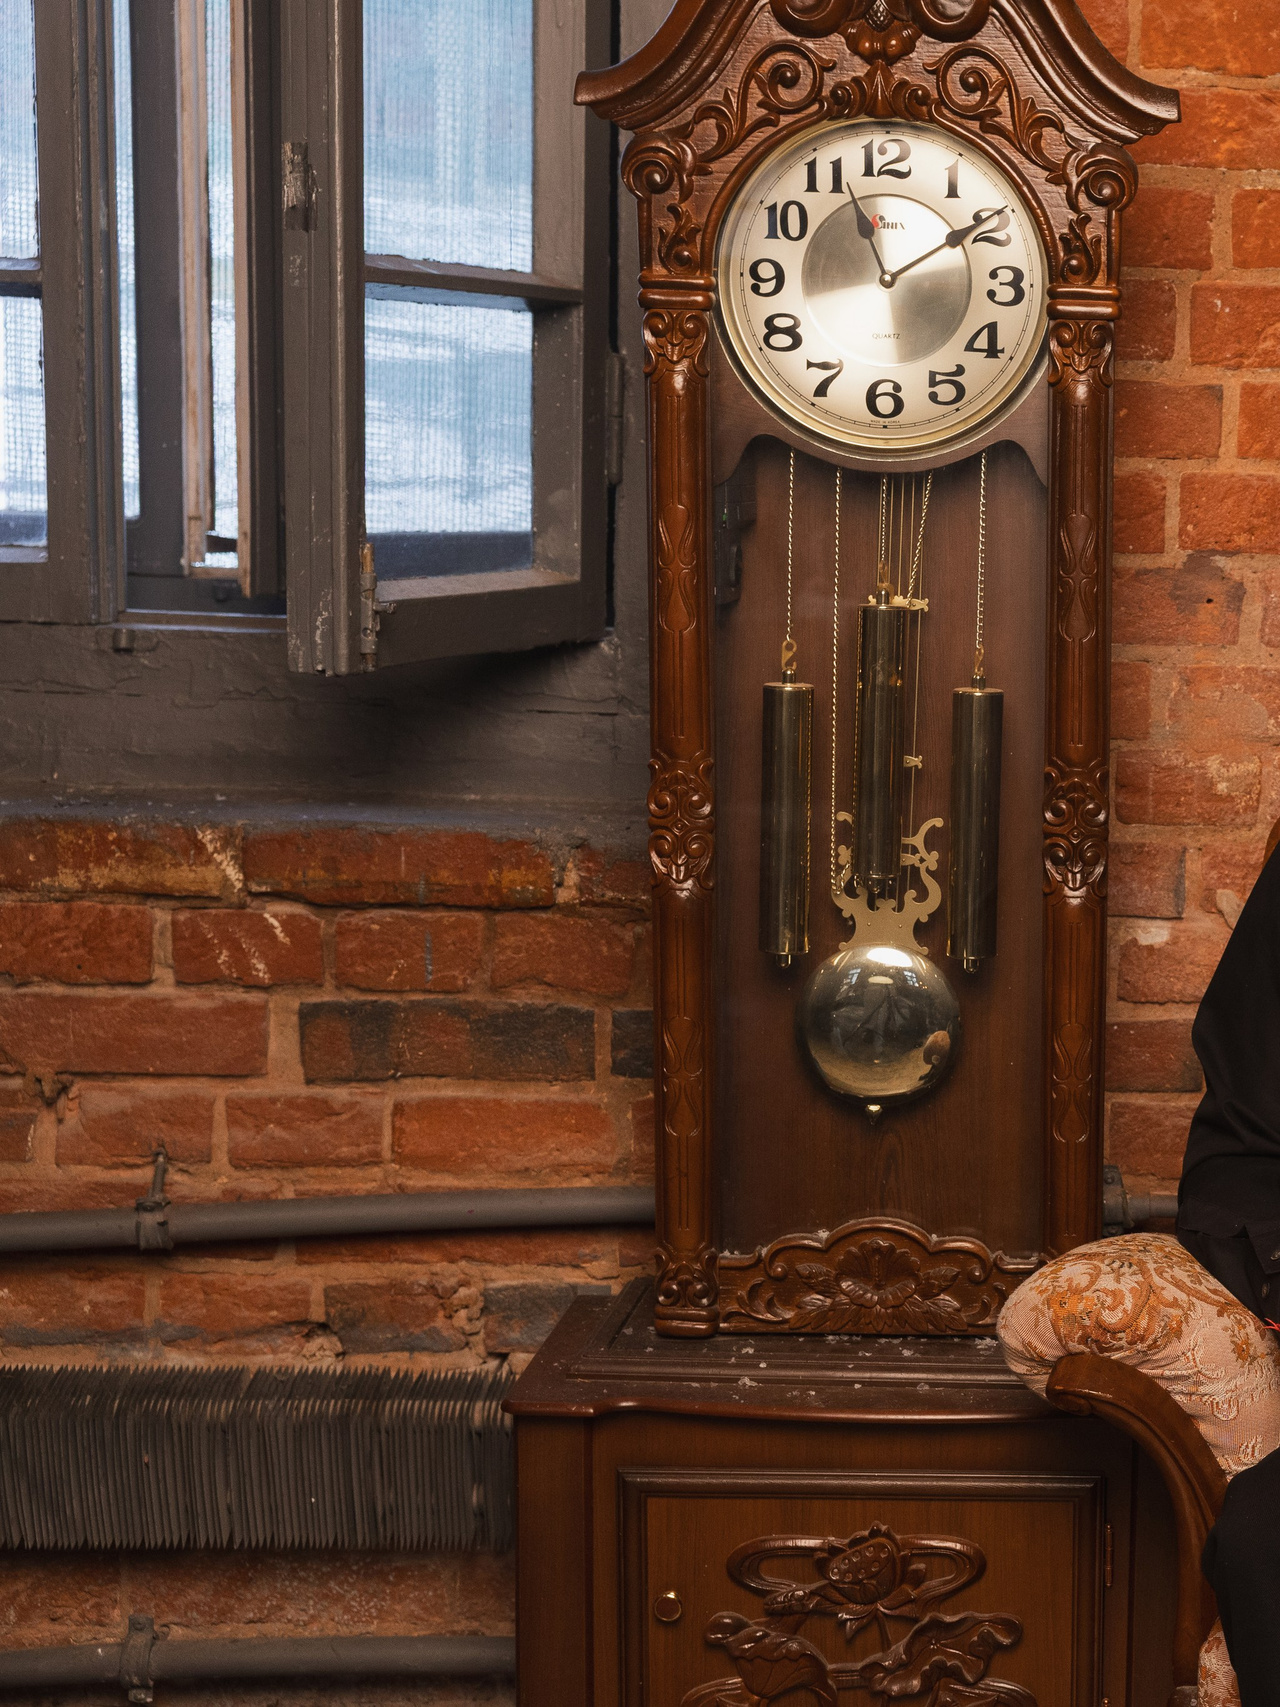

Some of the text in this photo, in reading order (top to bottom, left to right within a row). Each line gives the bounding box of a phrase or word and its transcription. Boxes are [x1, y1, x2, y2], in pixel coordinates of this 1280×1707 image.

[803, 156, 846, 194] 11
[861, 138, 912, 180] 12
[944, 159, 962, 199] 1
[764, 200, 809, 242] 10
[971, 207, 1012, 248] 2
[749, 258, 786, 298] 9
[986, 265, 1026, 307] 3
[762, 312, 803, 352] 8
[964, 321, 1005, 359] 4
[806, 358, 844, 398] 7
[928, 363, 966, 406] 5
[865, 378, 905, 419] 6
